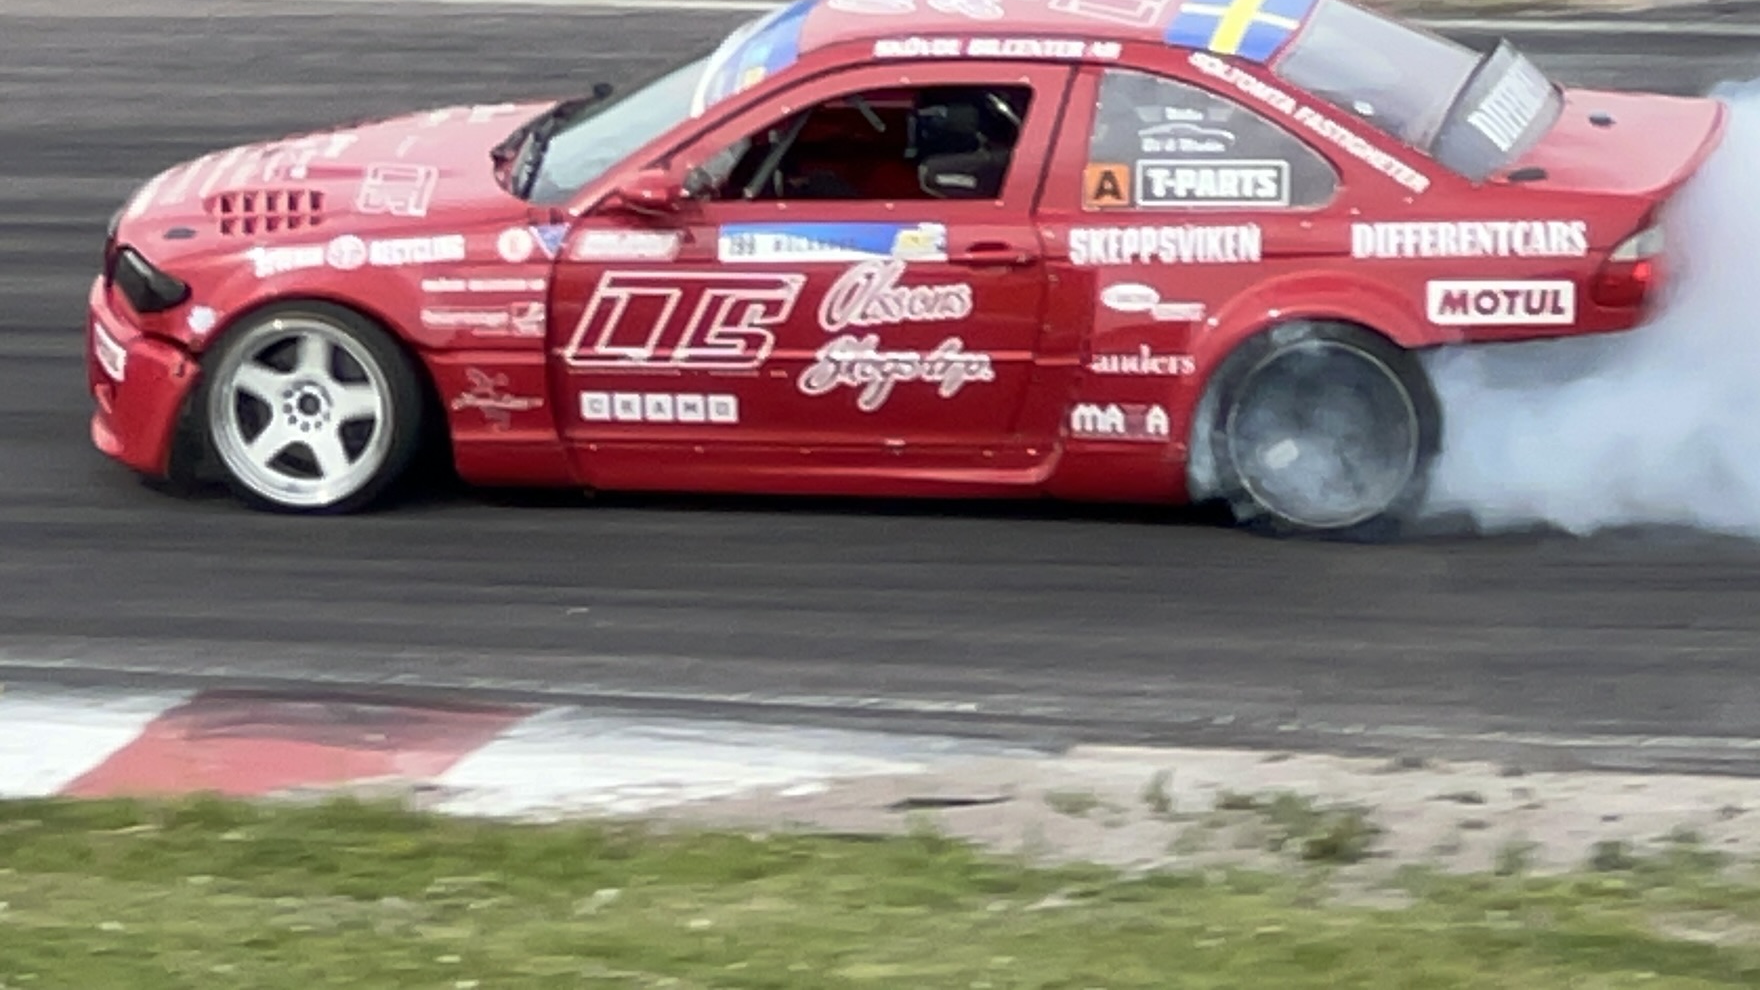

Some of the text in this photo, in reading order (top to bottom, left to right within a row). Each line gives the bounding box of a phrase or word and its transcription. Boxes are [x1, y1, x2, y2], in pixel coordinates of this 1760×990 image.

[1094, 170, 1122, 199] A
[1146, 166, 1279, 198] T-PARTS
[1069, 223, 1262, 266] SKEPPSVIKEN
[1351, 220, 1587, 258] DIFFERENTCARS
[1437, 288, 1566, 316] MOTUL
[584, 396, 735, 419] CRAMO
